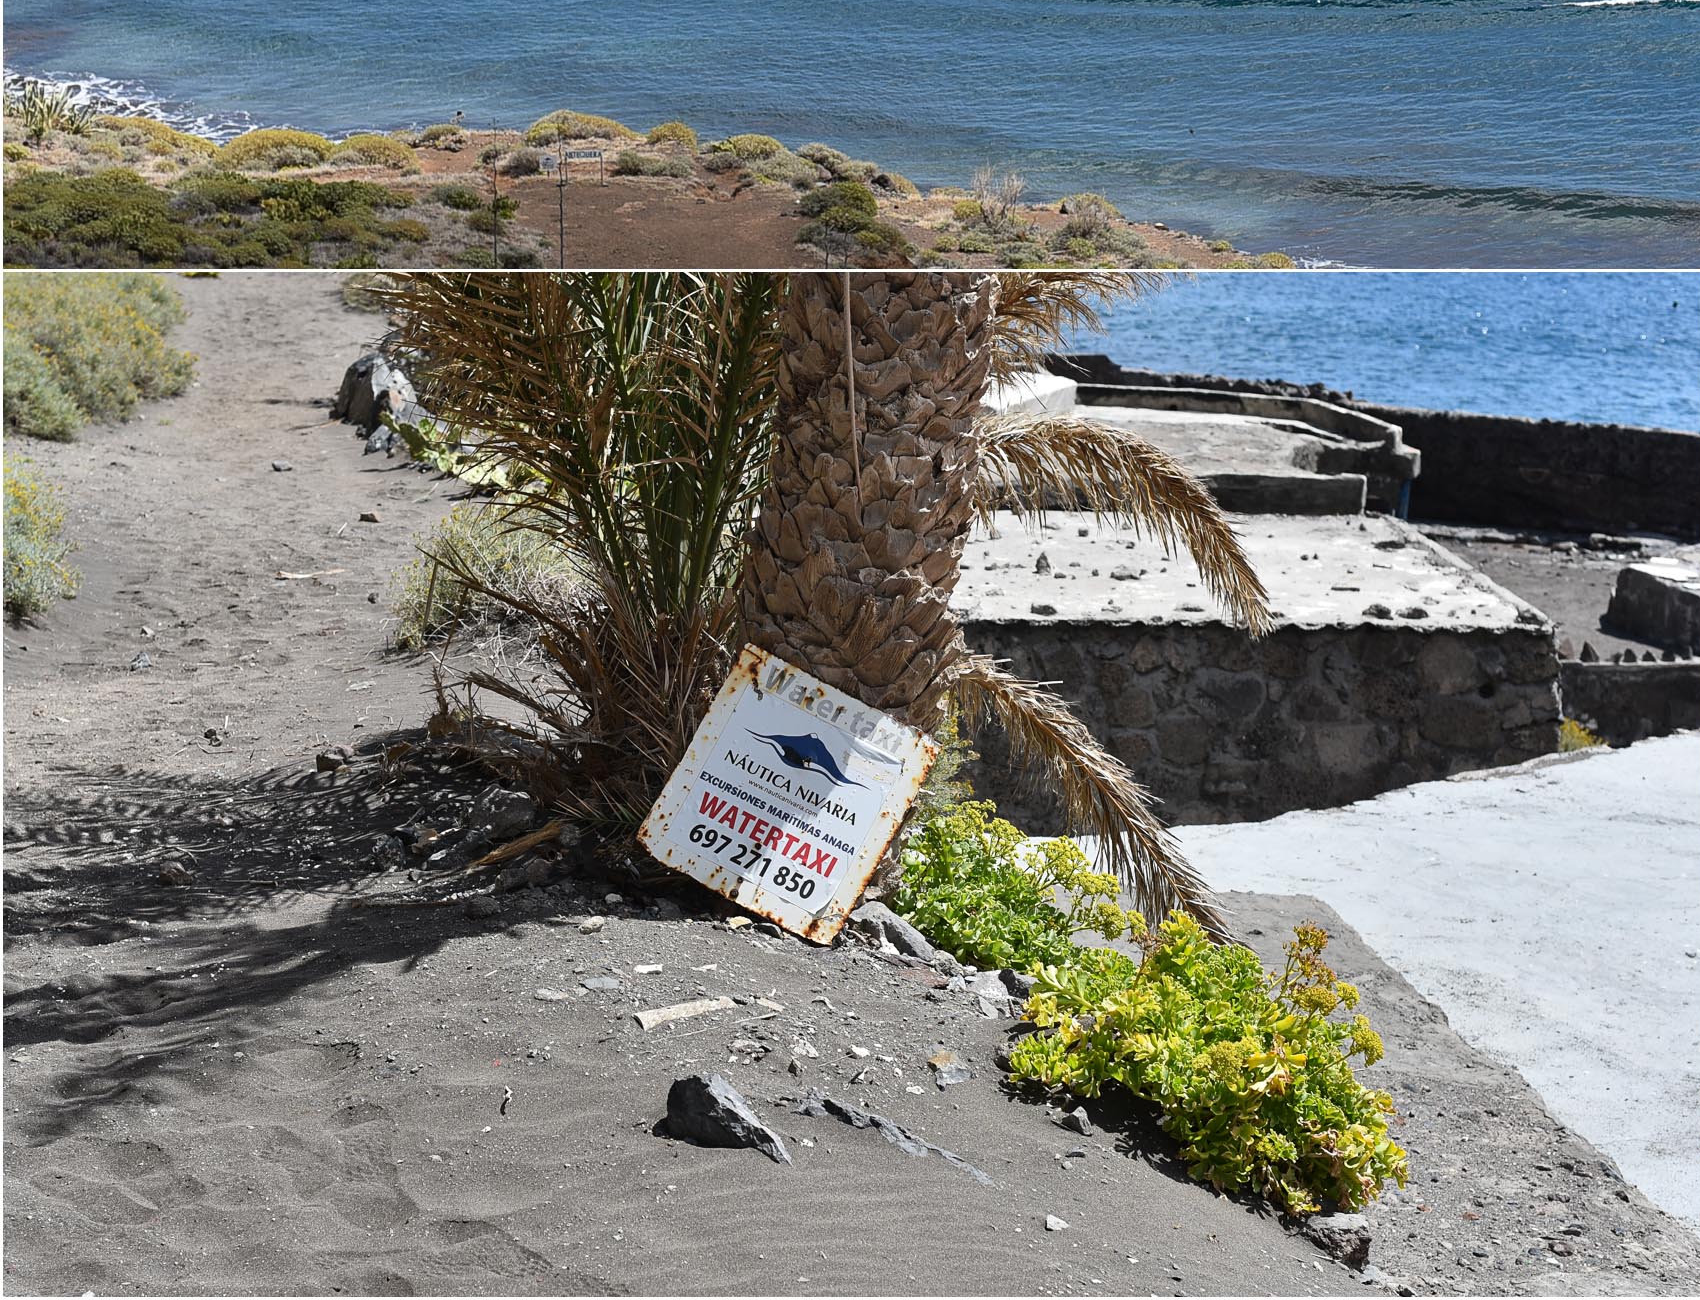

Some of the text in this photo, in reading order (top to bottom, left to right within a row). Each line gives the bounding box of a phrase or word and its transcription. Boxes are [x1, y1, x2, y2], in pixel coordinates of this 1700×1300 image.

[765, 664, 906, 753] Water taxi
[700, 771, 855, 855] EXCURSIONES MARÍTIMAS ANAGA
[724, 750, 857, 826] NÁUTICA NIVARIA
[748, 779, 818, 818] www.nauticanivaria.com
[689, 824, 815, 899] 697 271 850
[699, 791, 838, 878] WATERTAXI
